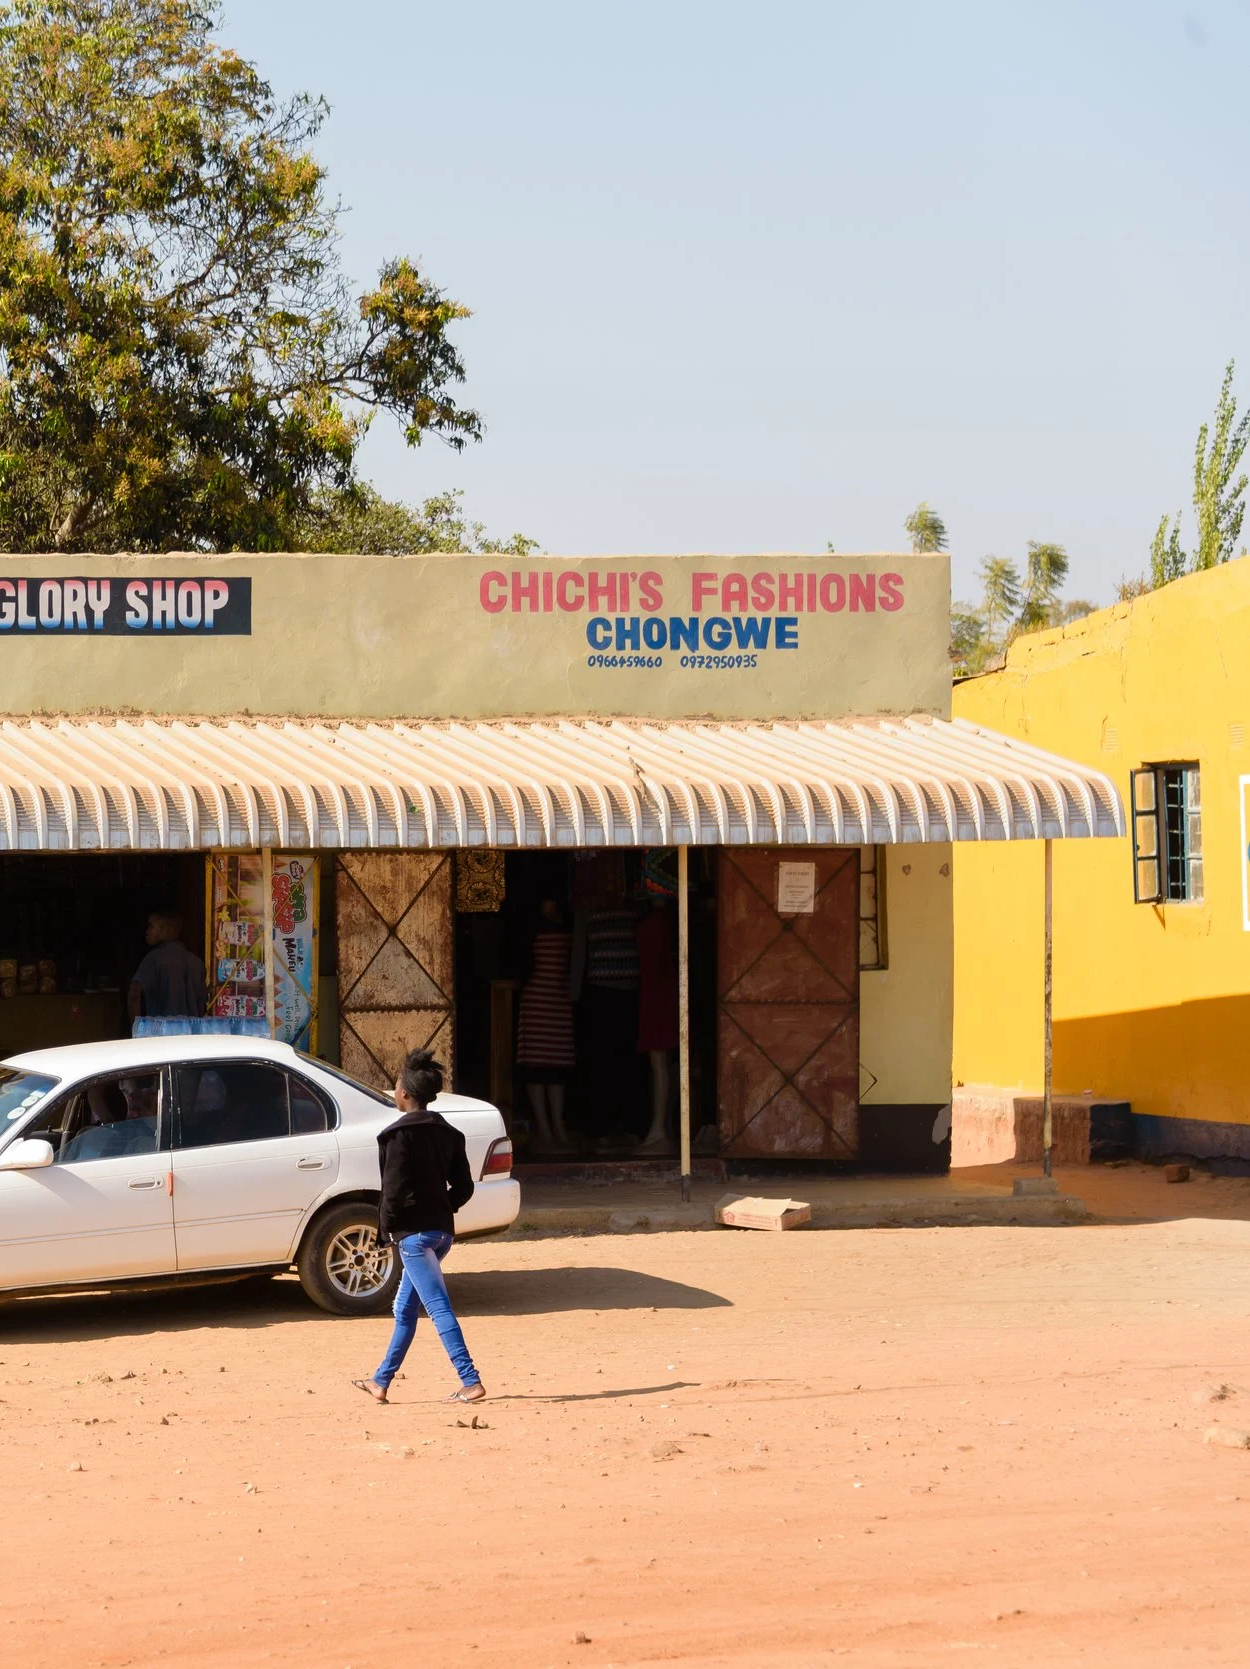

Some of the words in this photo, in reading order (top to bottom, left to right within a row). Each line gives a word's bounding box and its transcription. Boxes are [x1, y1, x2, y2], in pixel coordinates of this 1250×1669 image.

[125, 580, 230, 629] SHOP
[479, 571, 663, 614] CHICHI'S
[692, 572, 905, 614] FASHIONS
[586, 616, 799, 653] CHONGWE
[587, 655, 663, 668] 0966459660
[680, 654, 758, 669] 0972950935
